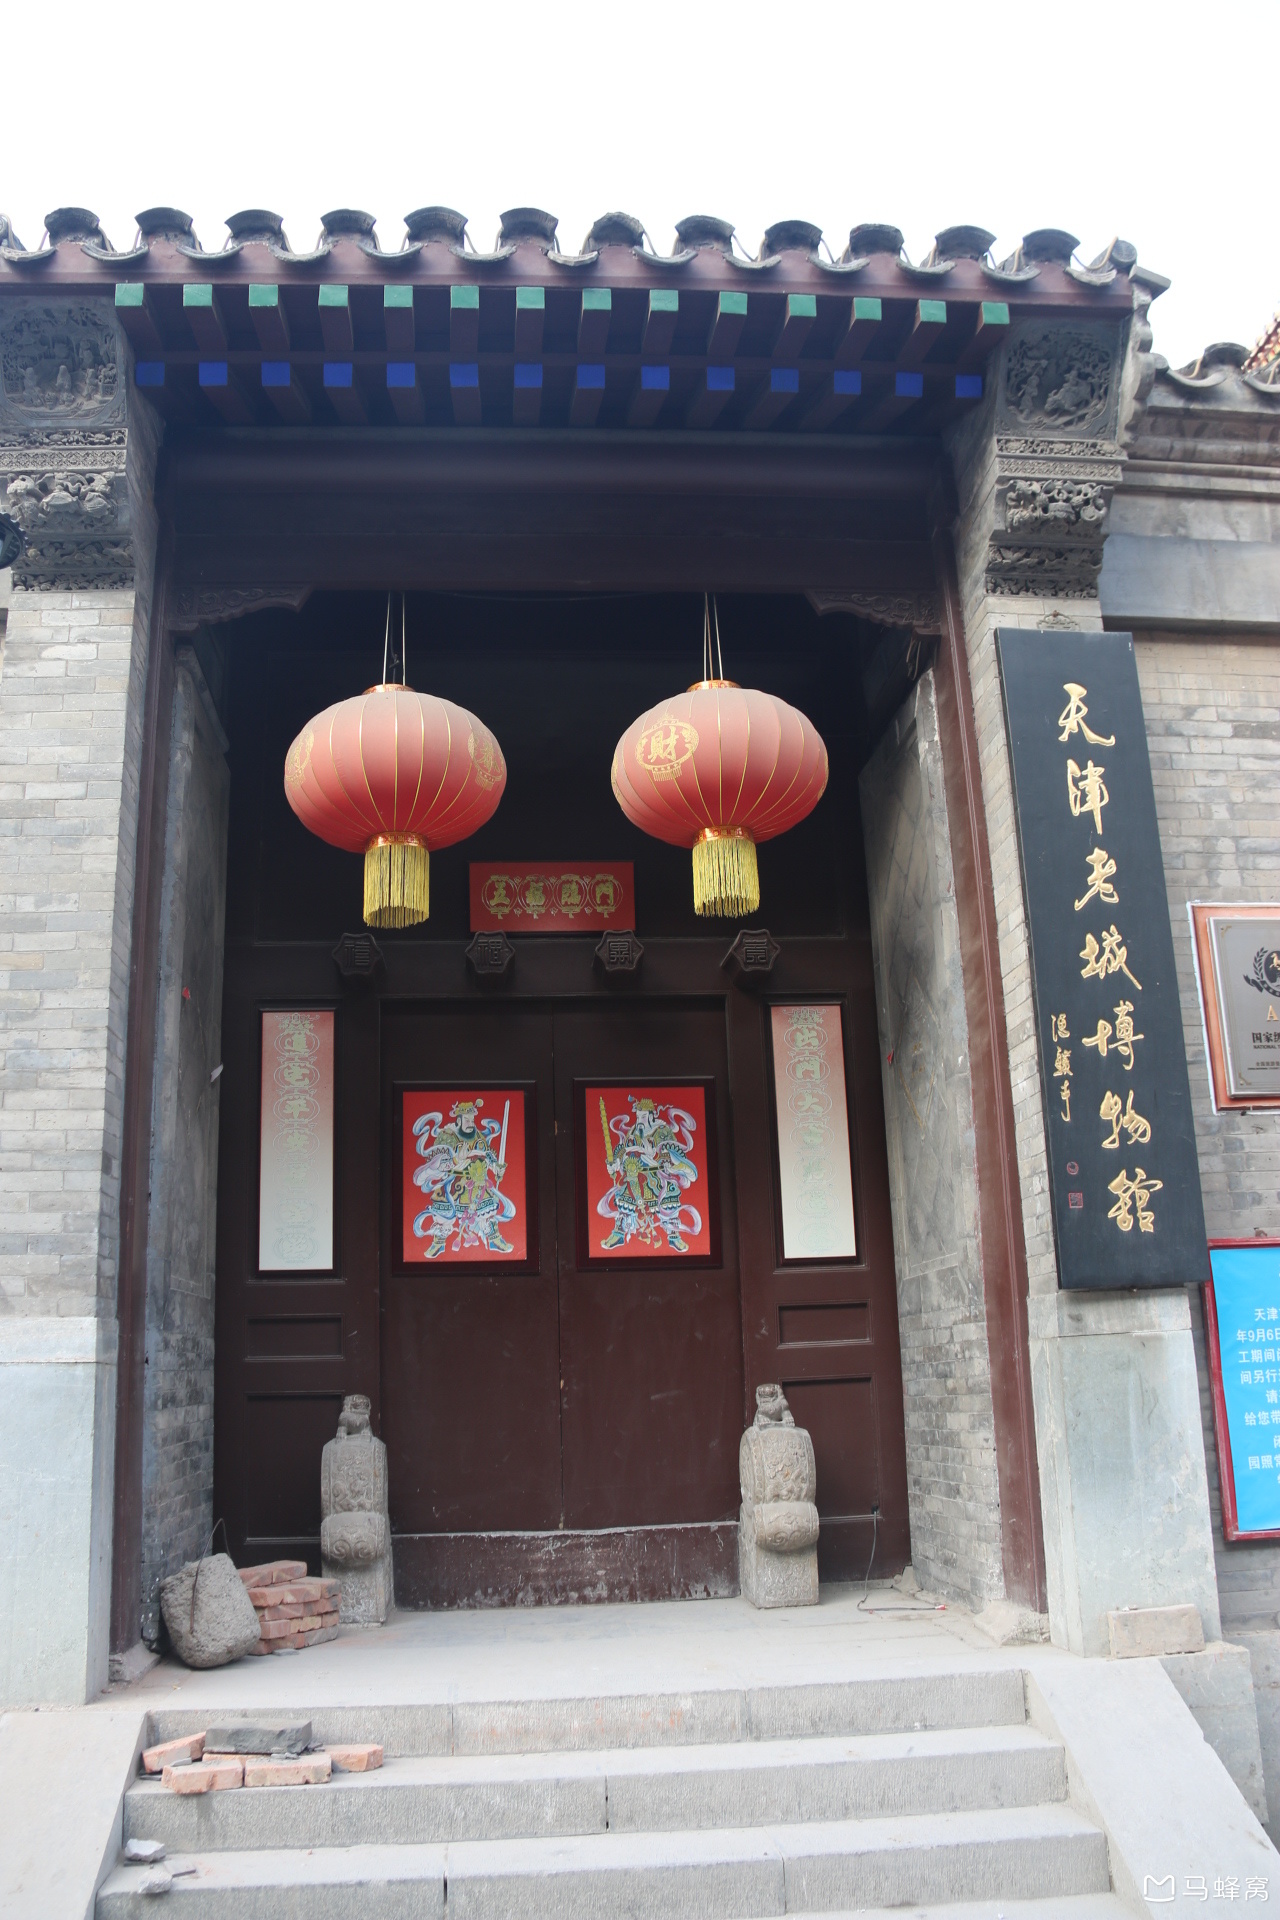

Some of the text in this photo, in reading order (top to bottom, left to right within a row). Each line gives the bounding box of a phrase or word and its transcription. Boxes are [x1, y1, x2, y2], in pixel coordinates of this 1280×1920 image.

[1254, 1307, 1280, 1321] 天津
[1238, 1348, 1280, 1363] 工期间
[1240, 1368, 1280, 1384] 间另行
[1265, 1389, 1280, 1404] 请
